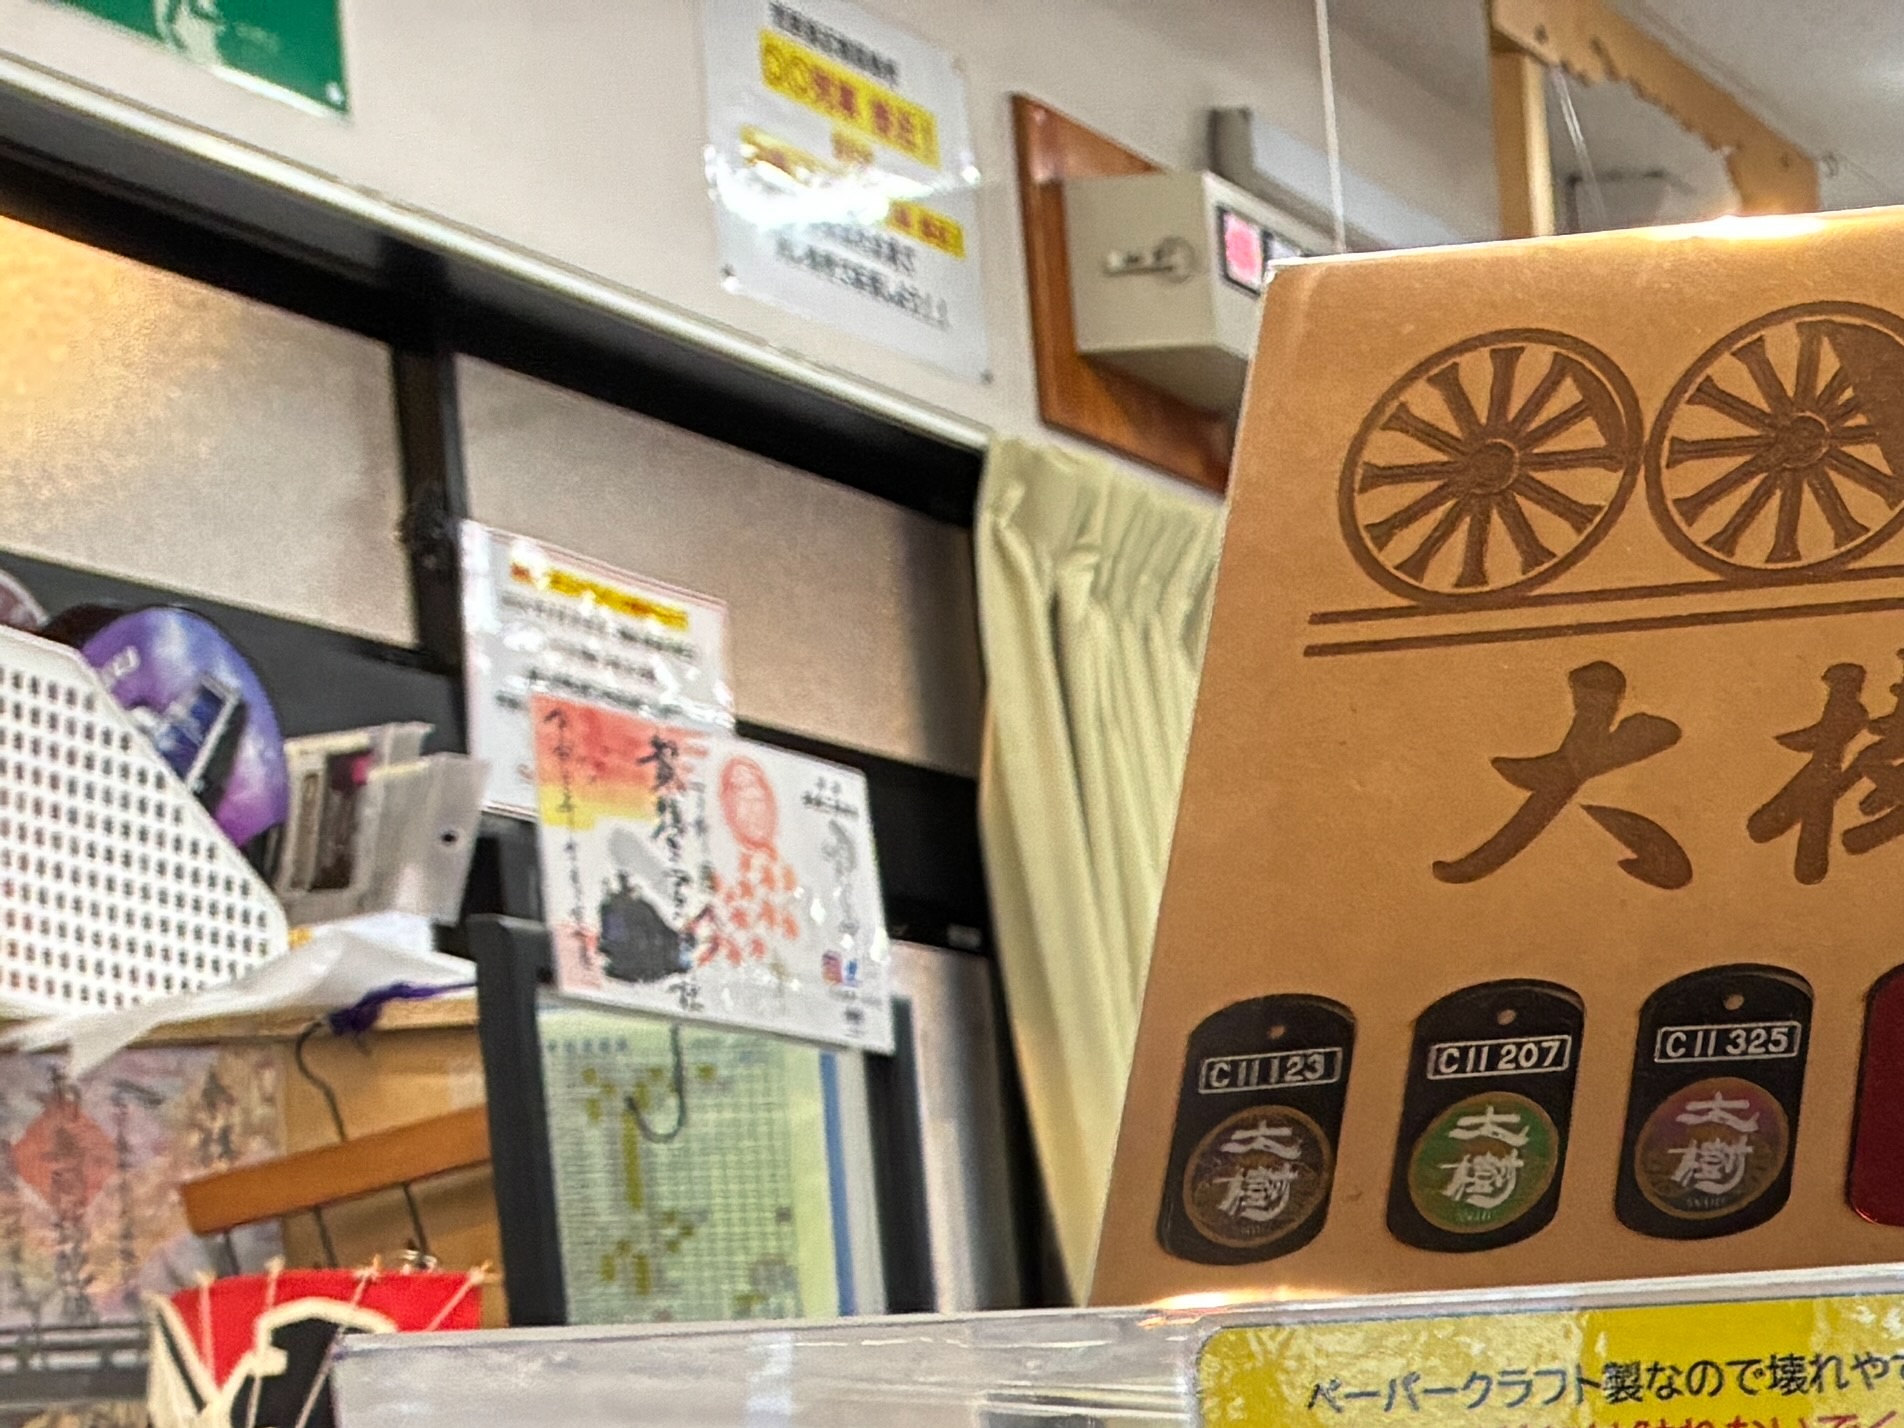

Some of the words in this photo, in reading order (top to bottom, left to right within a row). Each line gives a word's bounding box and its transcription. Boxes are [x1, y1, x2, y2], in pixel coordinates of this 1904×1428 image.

[1497, 1041, 1561, 1070] 207
[1726, 1027, 1789, 1055] 325
[1269, 1054, 1325, 1084] 123
